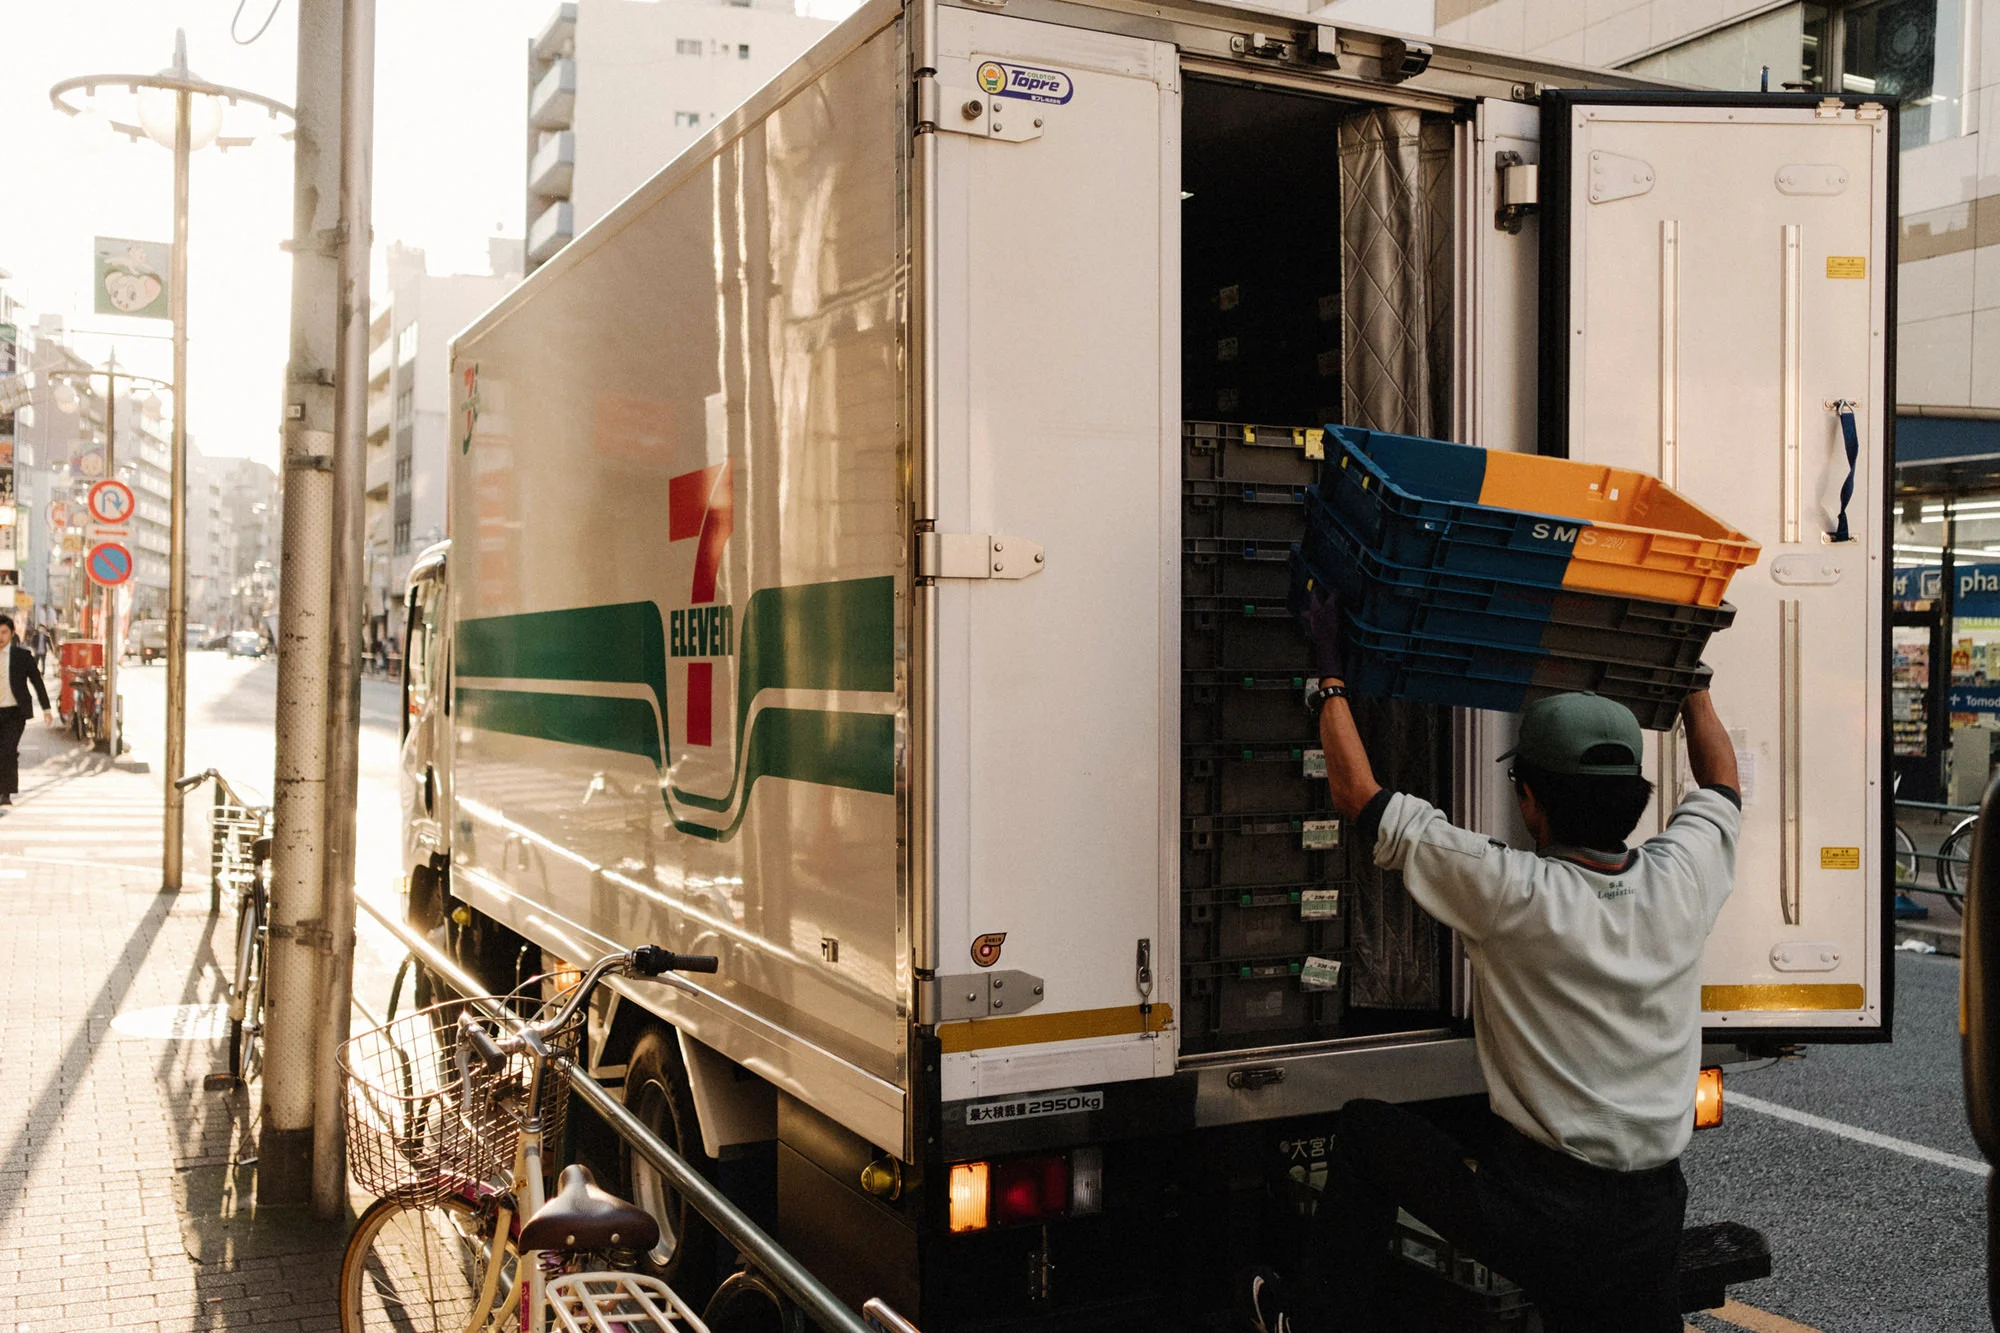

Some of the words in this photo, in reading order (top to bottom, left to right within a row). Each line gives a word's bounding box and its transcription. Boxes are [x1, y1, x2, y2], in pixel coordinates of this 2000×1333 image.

[1011, 70, 1060, 91] Topre
[1027, 72, 1057, 81] COLDTOP
[1532, 523, 1599, 546] SMS
[1960, 569, 2000, 599] pha
[1291, 1138, 1326, 1160] 大宮
